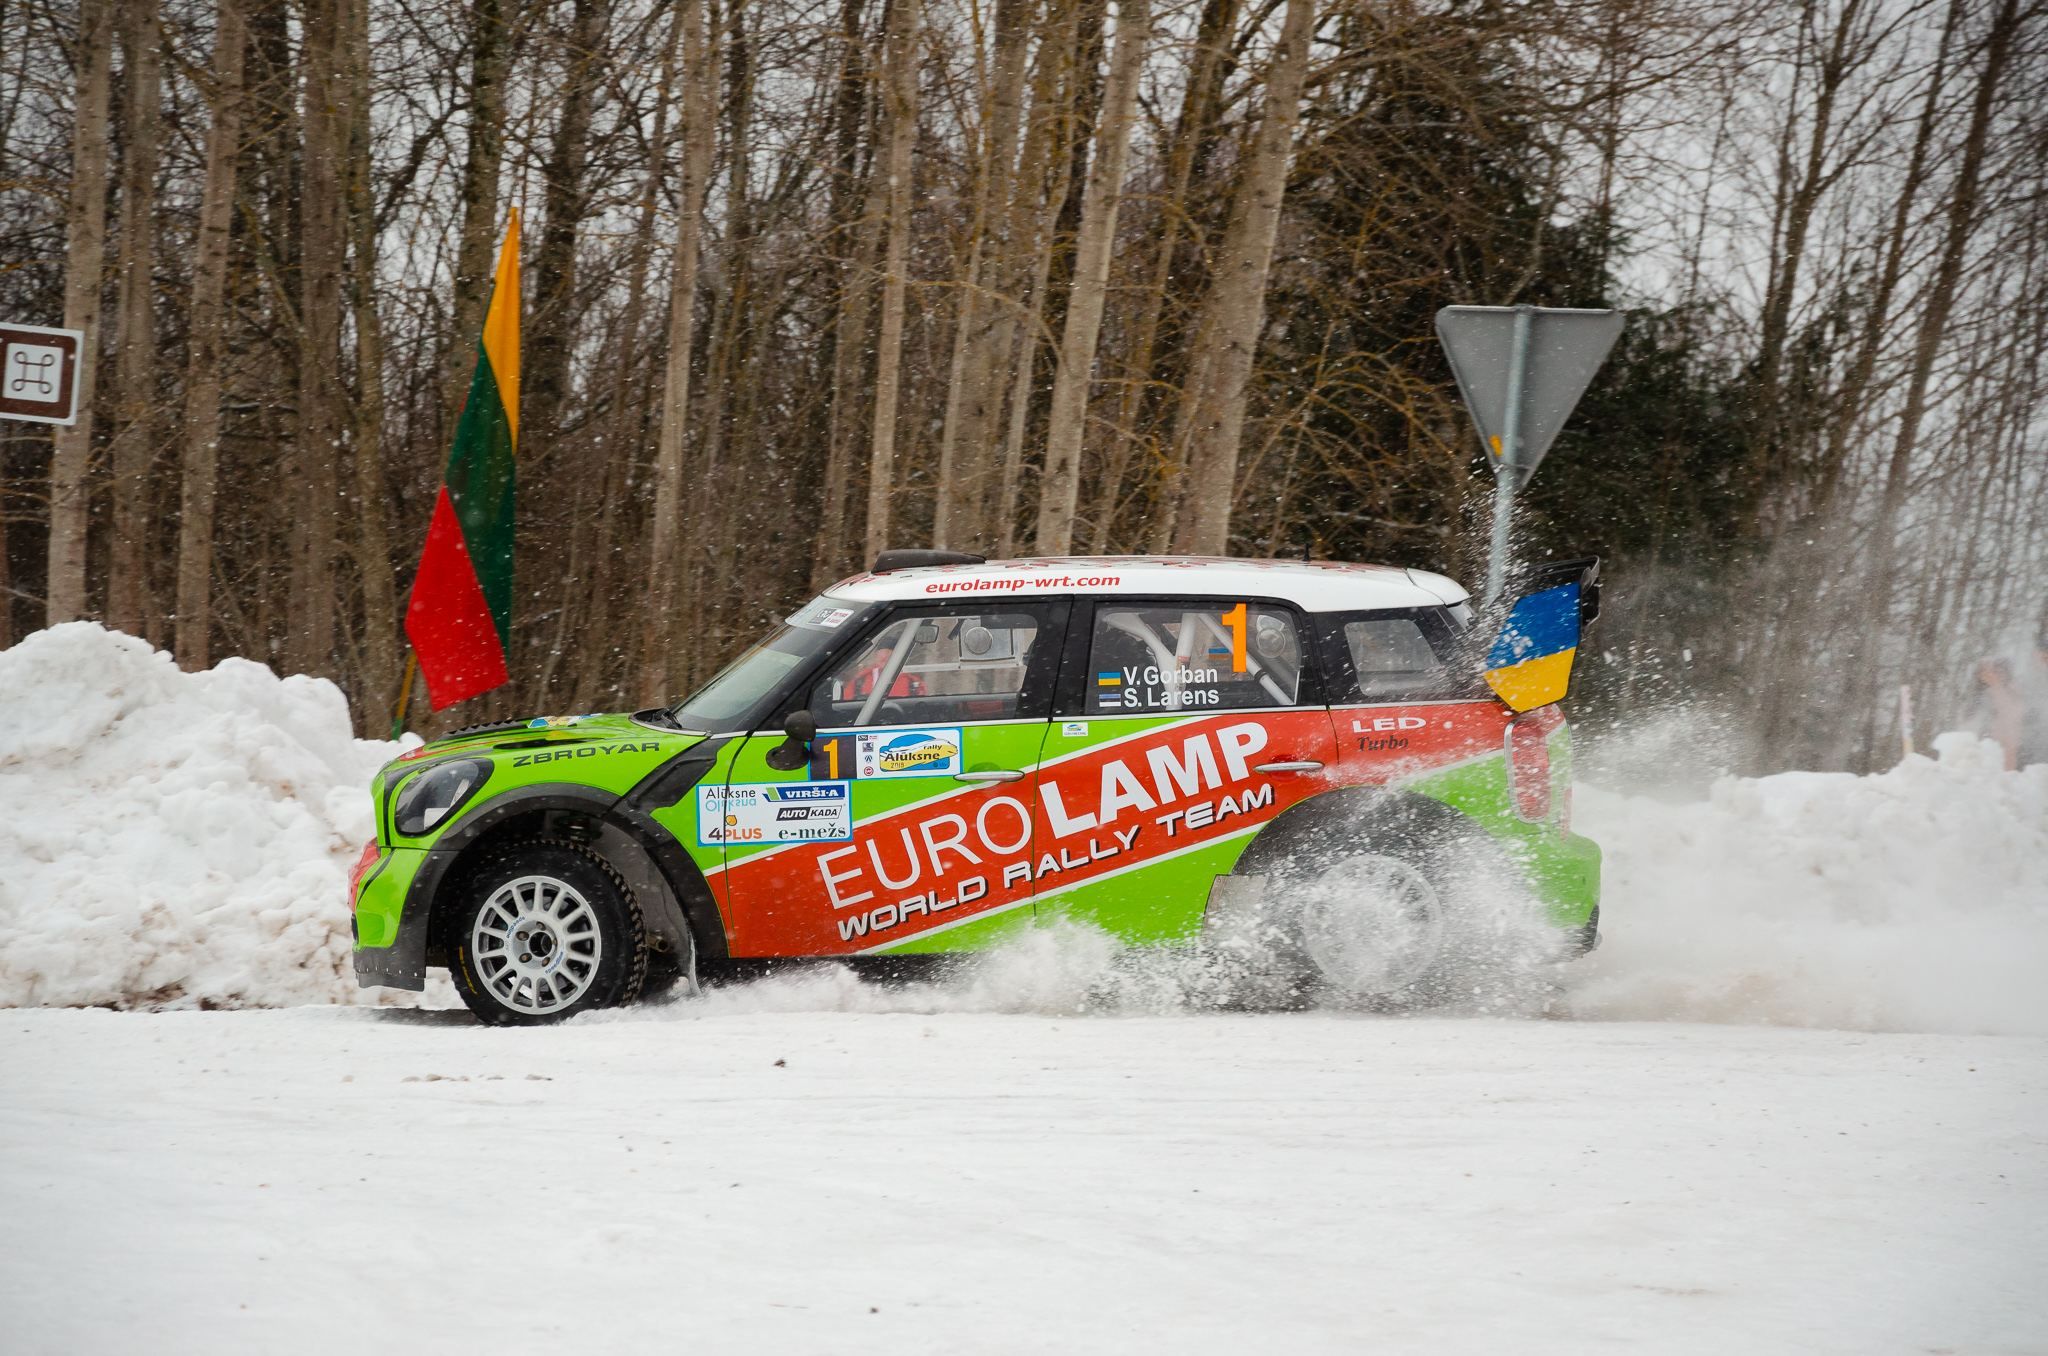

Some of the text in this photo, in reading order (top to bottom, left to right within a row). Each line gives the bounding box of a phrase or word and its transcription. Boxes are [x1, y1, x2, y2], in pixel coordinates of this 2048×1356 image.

[925, 575, 1121, 594] eurolamp-wrt.com
[1221, 603, 1247, 673] 1
[1143, 664, 1218, 686] Gorban
[1147, 687, 1220, 707] Larens
[1351, 717, 1427, 733] LED
[1357, 734, 1409, 752] Turbo
[512, 741, 660, 768] ZBROYAR
[823, 738, 839, 780] 1
[884, 751, 941, 762] Alūksne
[705, 786, 757, 800] Alūksne
[778, 822, 846, 840] e-mežs
[837, 783, 1273, 942] WORLD RALLY TEAM
